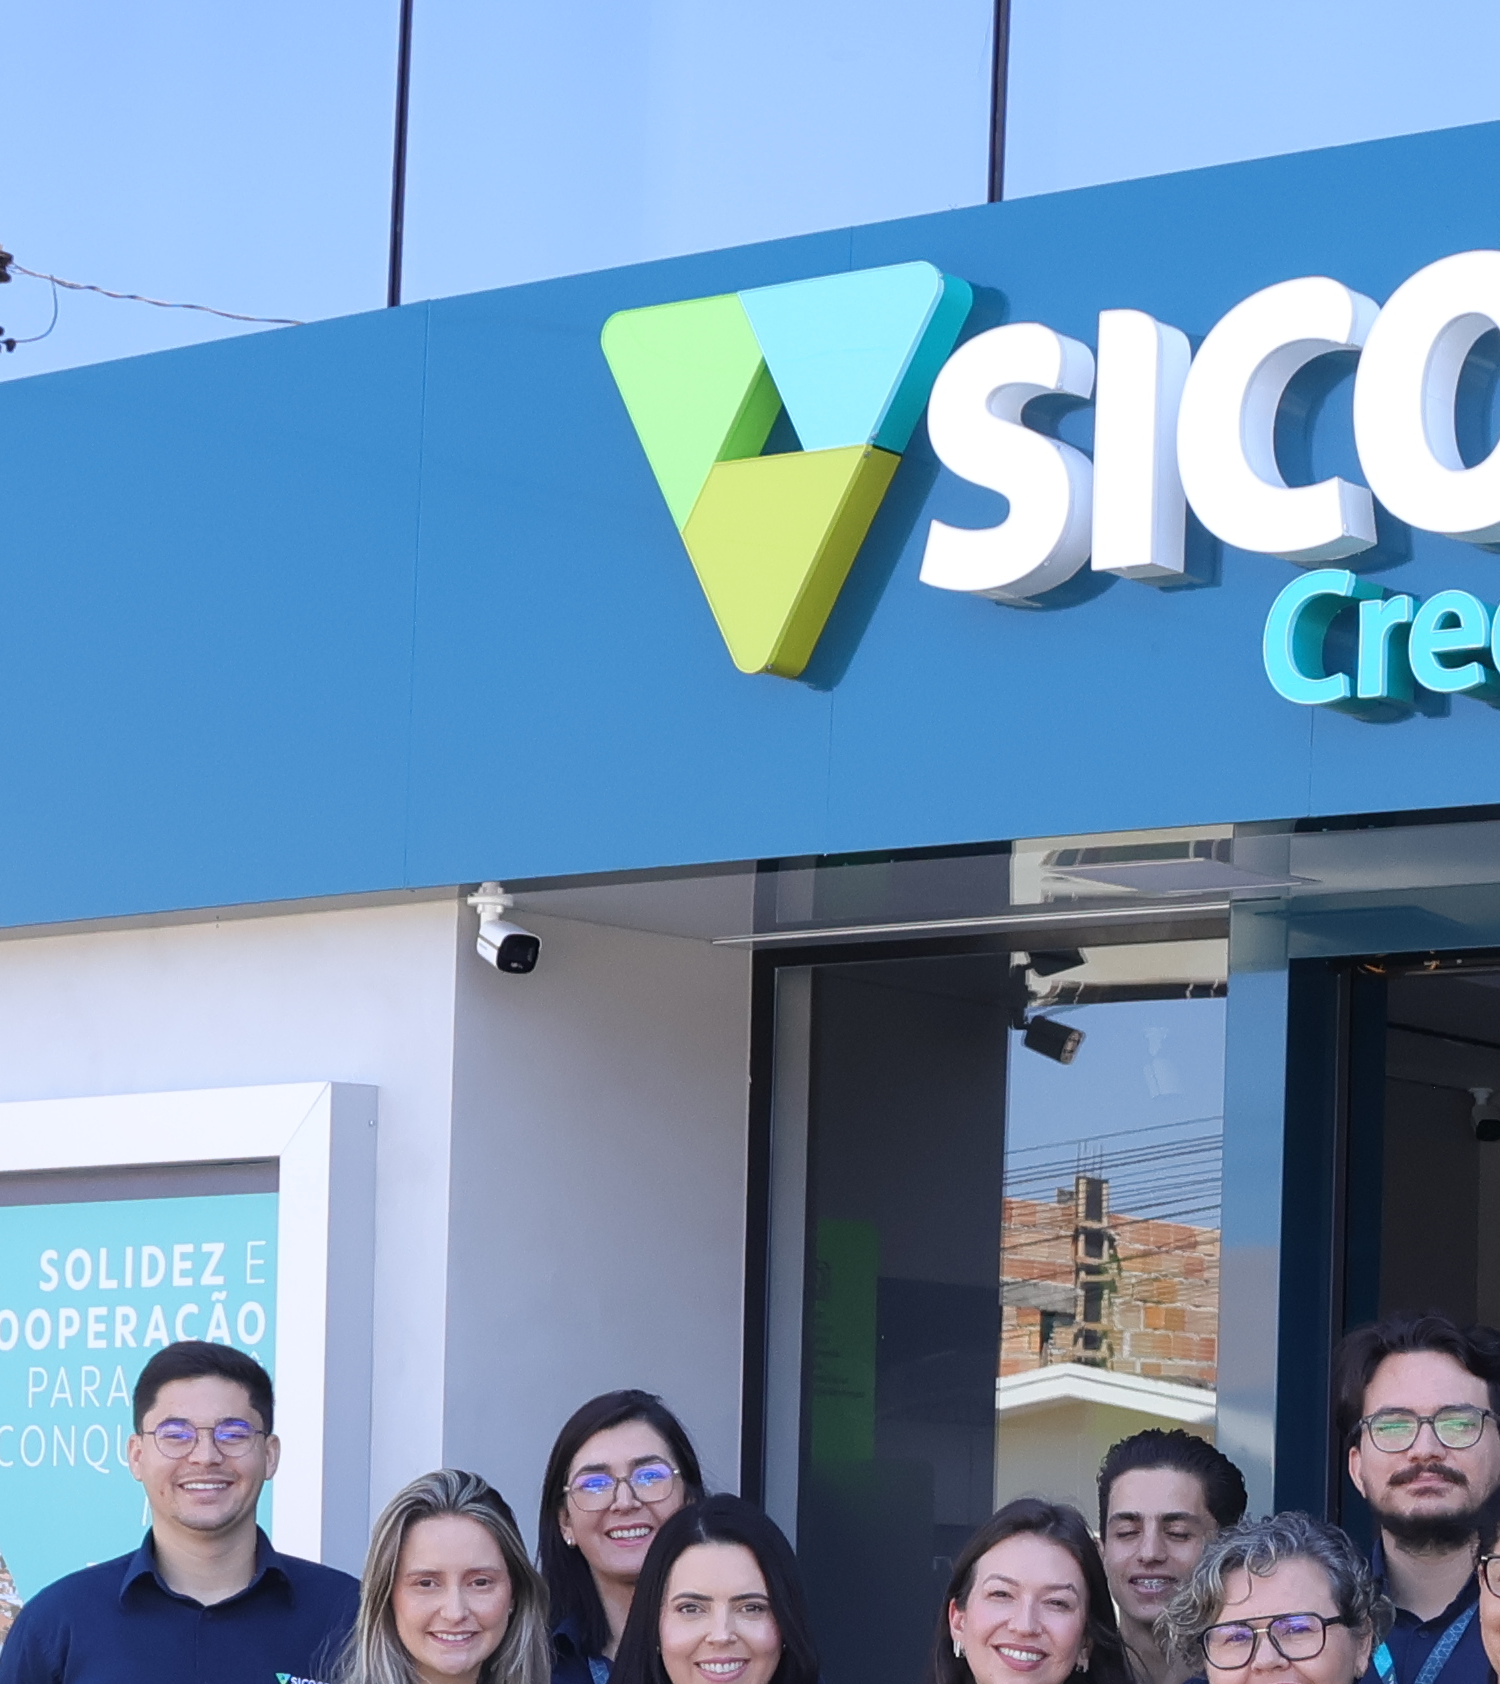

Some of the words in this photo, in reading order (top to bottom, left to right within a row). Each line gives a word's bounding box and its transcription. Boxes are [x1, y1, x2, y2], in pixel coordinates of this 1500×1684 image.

[39, 1243, 226, 1291] SOLIDEZ
[246, 1241, 267, 1284] E
[28, 1366, 130, 1408] PARA
